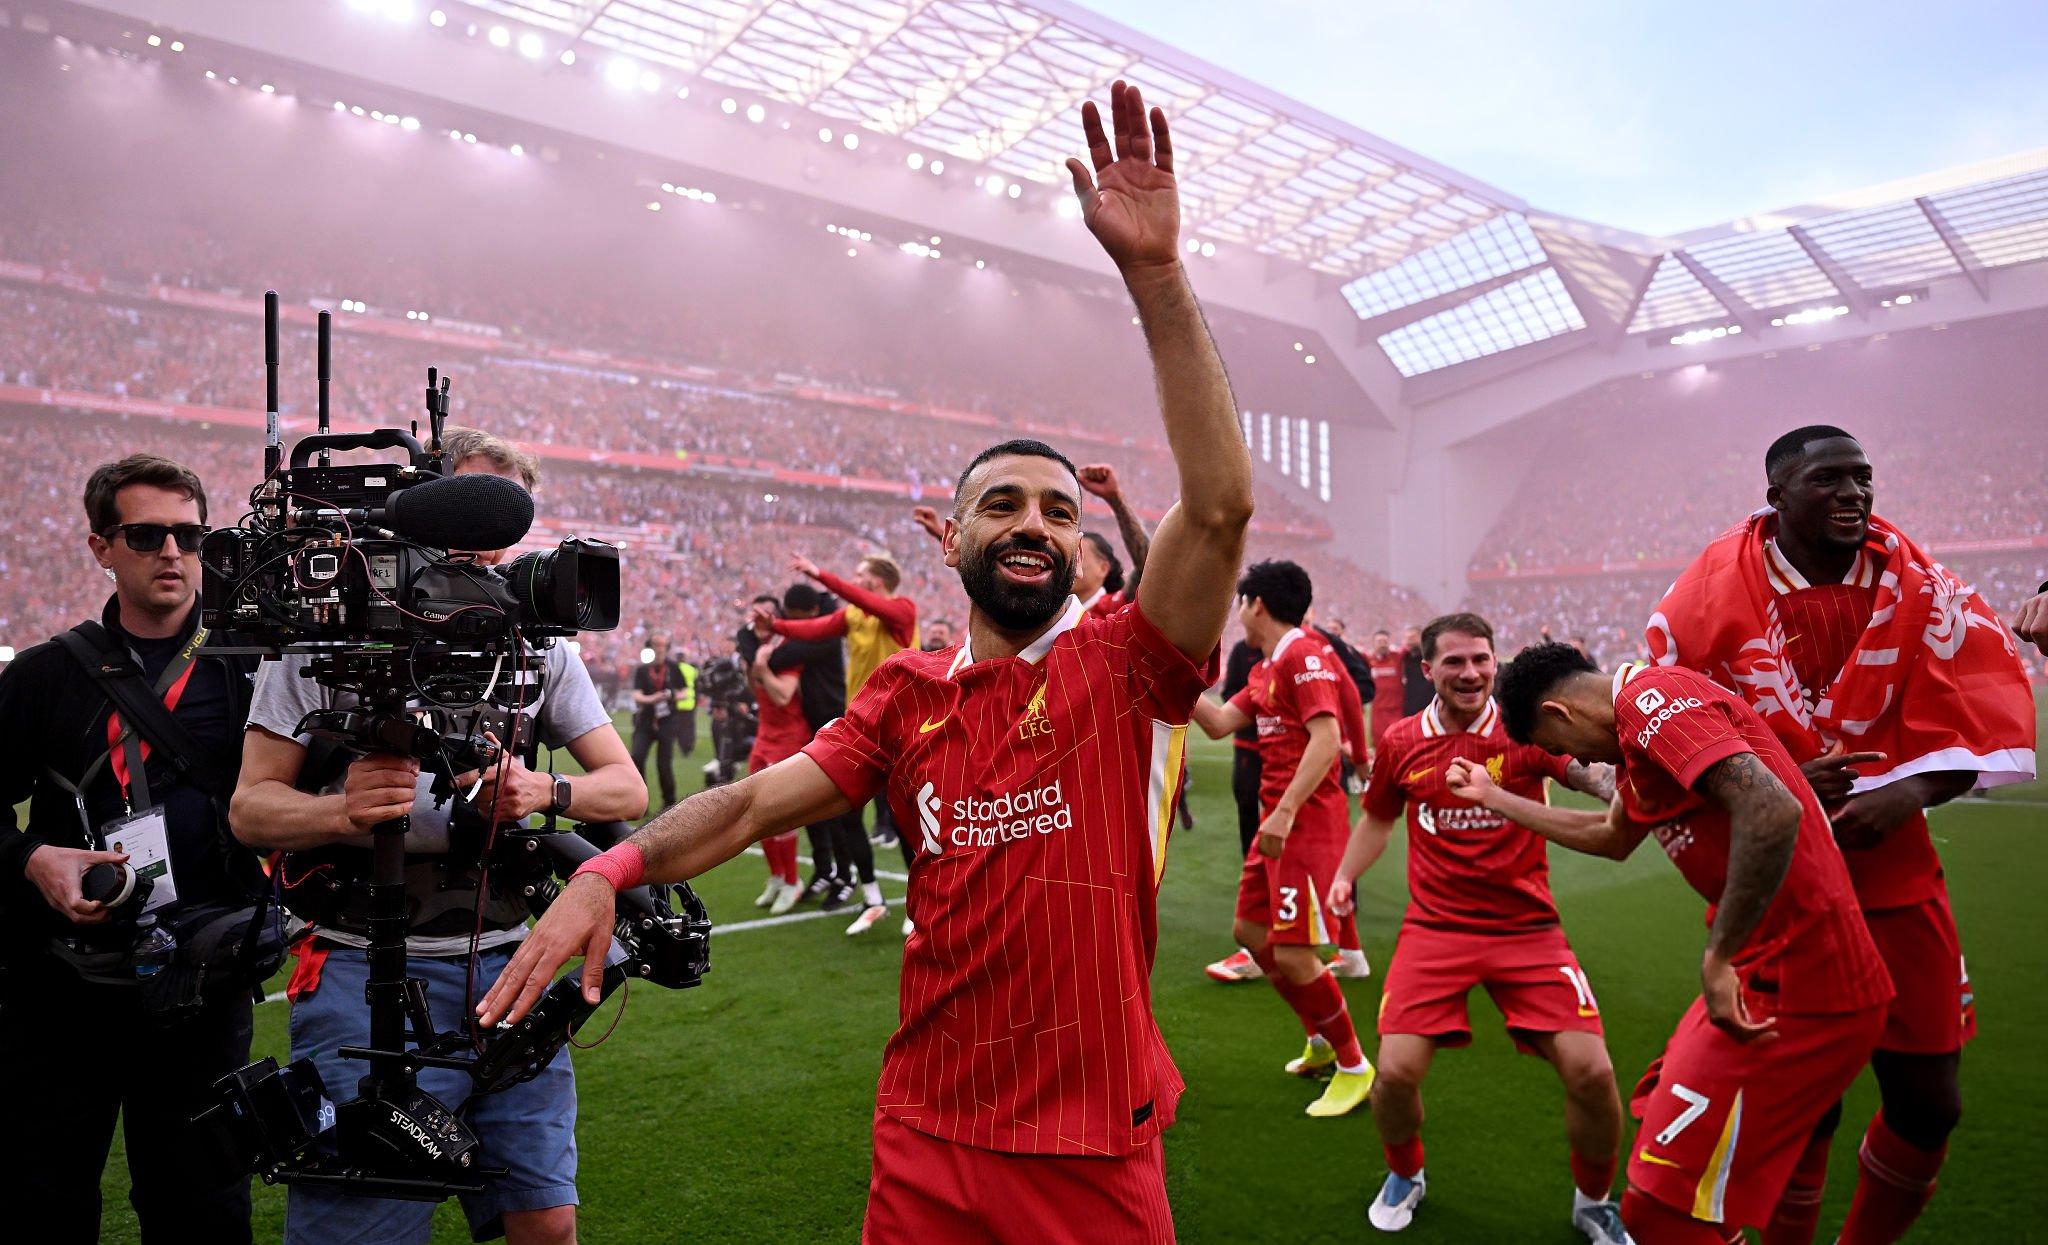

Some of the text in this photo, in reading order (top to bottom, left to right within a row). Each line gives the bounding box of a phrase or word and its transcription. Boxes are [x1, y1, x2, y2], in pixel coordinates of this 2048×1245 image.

[1637, 696, 1704, 749] Expedia
[953, 779, 1062, 821] stadard
[951, 804, 1073, 847] chartered
[1279, 886, 1298, 921] 3
[390, 1110, 442, 1160] STEADICAM
[1655, 1083, 1711, 1146] 7
